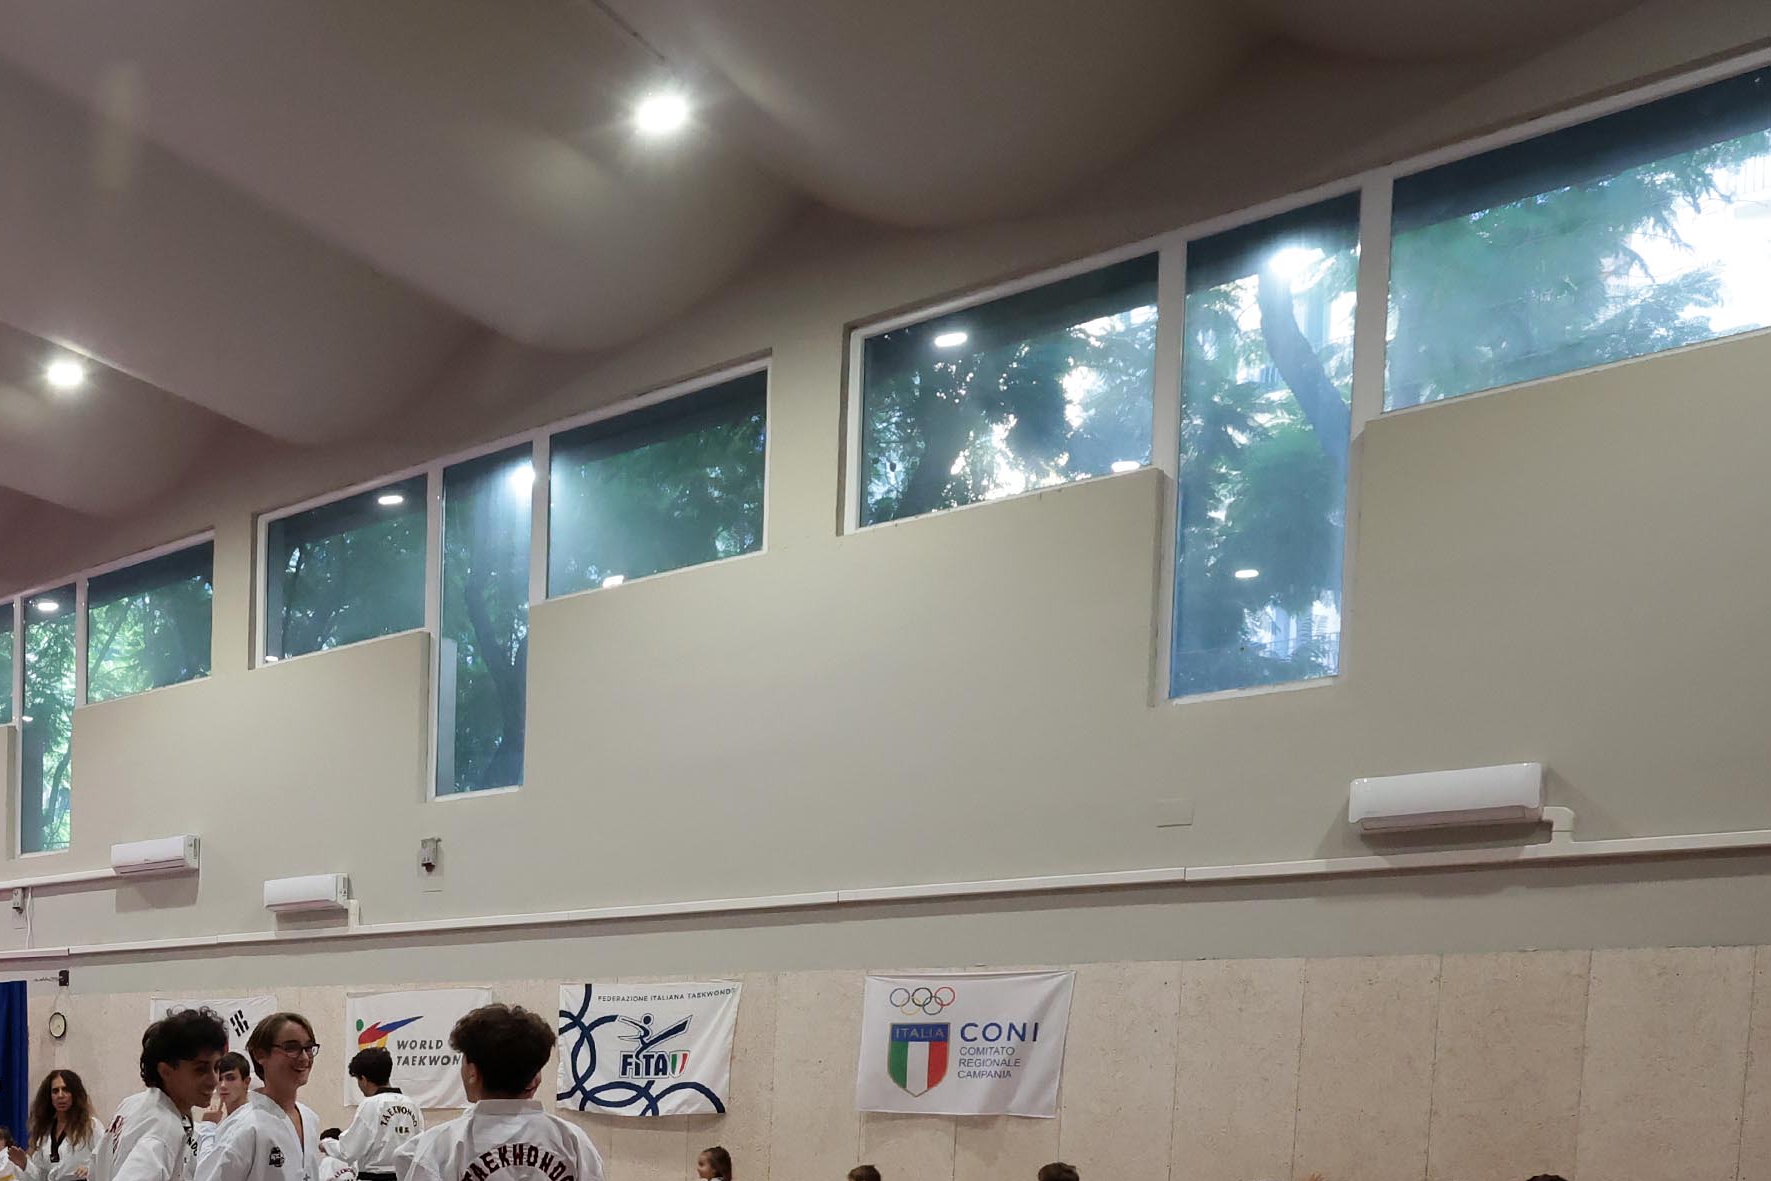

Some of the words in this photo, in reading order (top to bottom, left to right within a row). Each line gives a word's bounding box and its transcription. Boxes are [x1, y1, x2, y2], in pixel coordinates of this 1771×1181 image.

[650, 993, 684, 1001] ITALIANA
[893, 1027, 945, 1039] ITALIA
[960, 1022, 1039, 1042] CONI
[396, 1039, 443, 1050] WORLD
[959, 1046, 1016, 1056] COMITATO
[621, 1053, 668, 1076] FITA
[958, 1057, 1021, 1067] REGIONALE
[957, 1069, 1012, 1079] CAMPANIA
